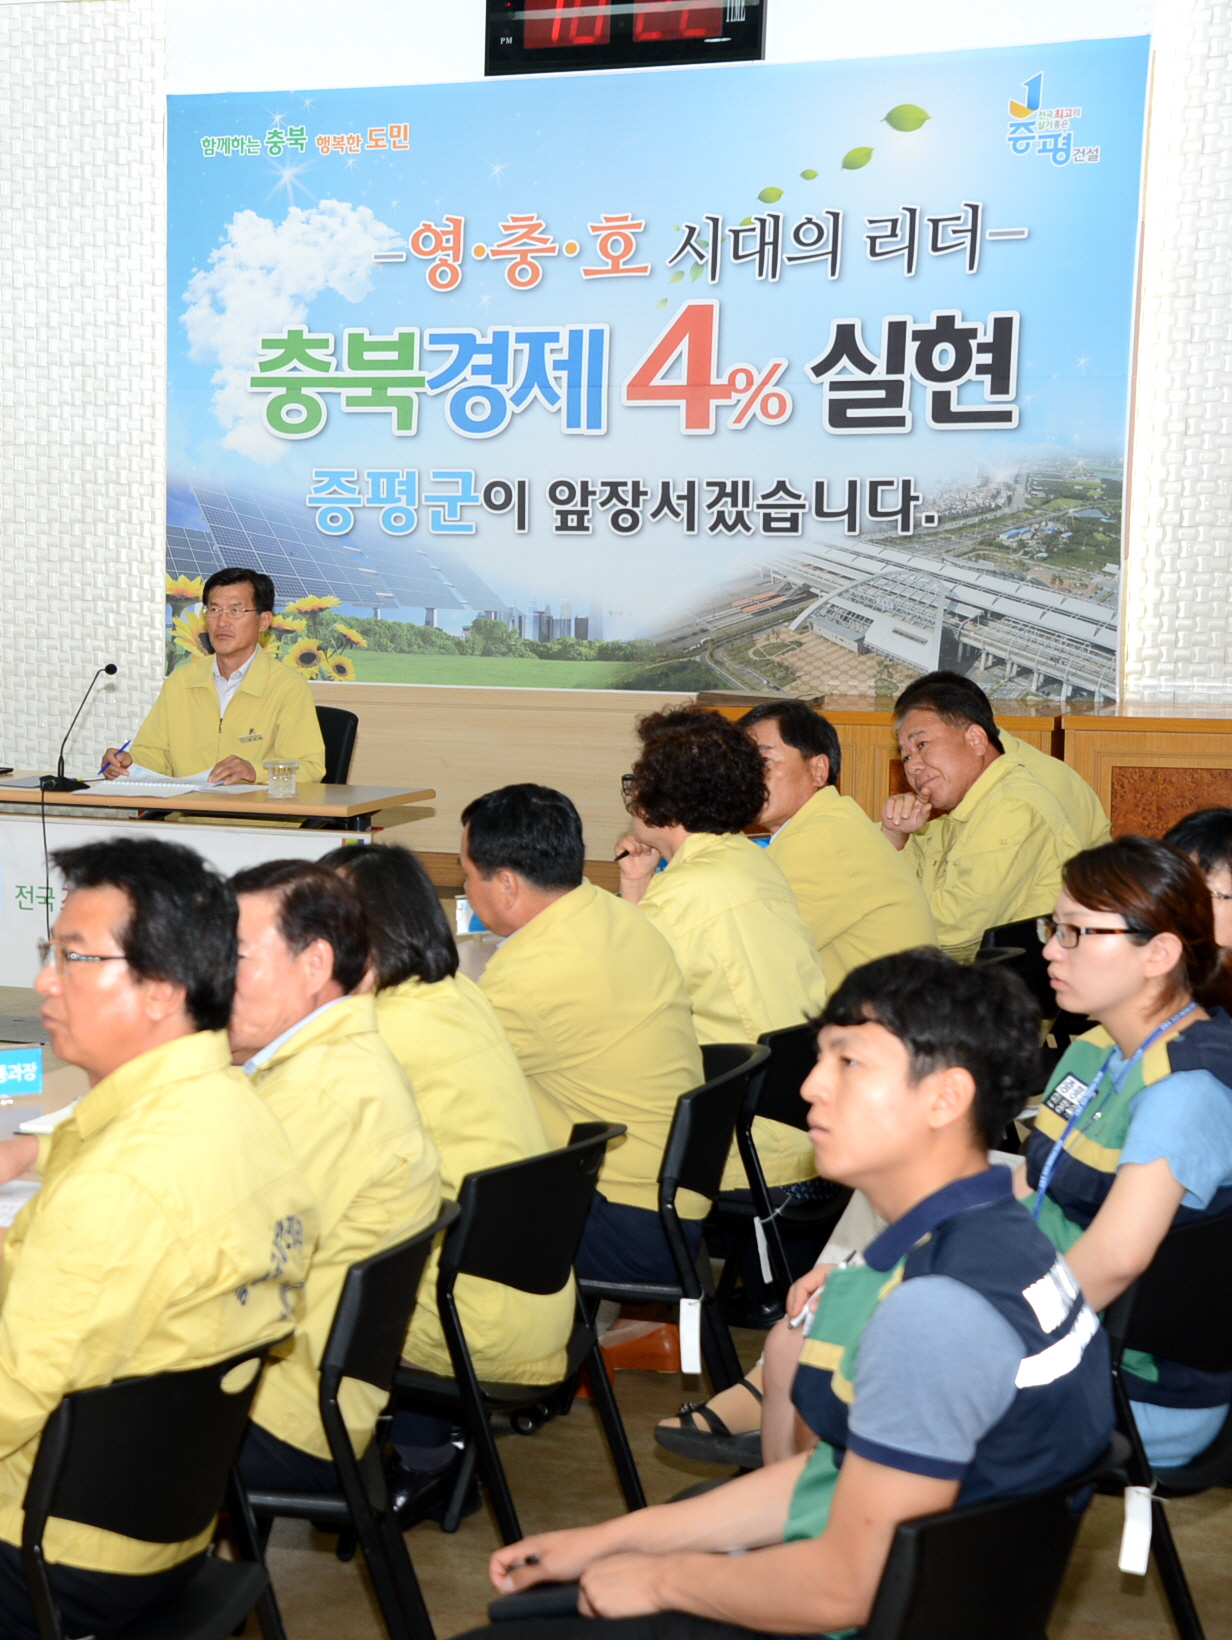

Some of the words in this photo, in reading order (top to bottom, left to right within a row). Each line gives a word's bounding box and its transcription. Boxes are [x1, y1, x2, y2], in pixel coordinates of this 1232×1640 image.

[500, 37, 513, 45] PM
[201, 136, 261, 156] 함께하는
[265, 126, 308, 155] 충북
[315, 134, 362, 154] 행복한
[366, 124, 409, 150] 도민
[668, 210, 842, 282] 시대의
[866, 203, 983, 275] 리더
[625, 303, 788, 430] 4%
[809, 314, 1015, 429] 실현
[309, 469, 528, 533] 증평군이
[548, 479, 939, 533] 앞장서겠습니다.
[14, 885, 56, 912] 전국
